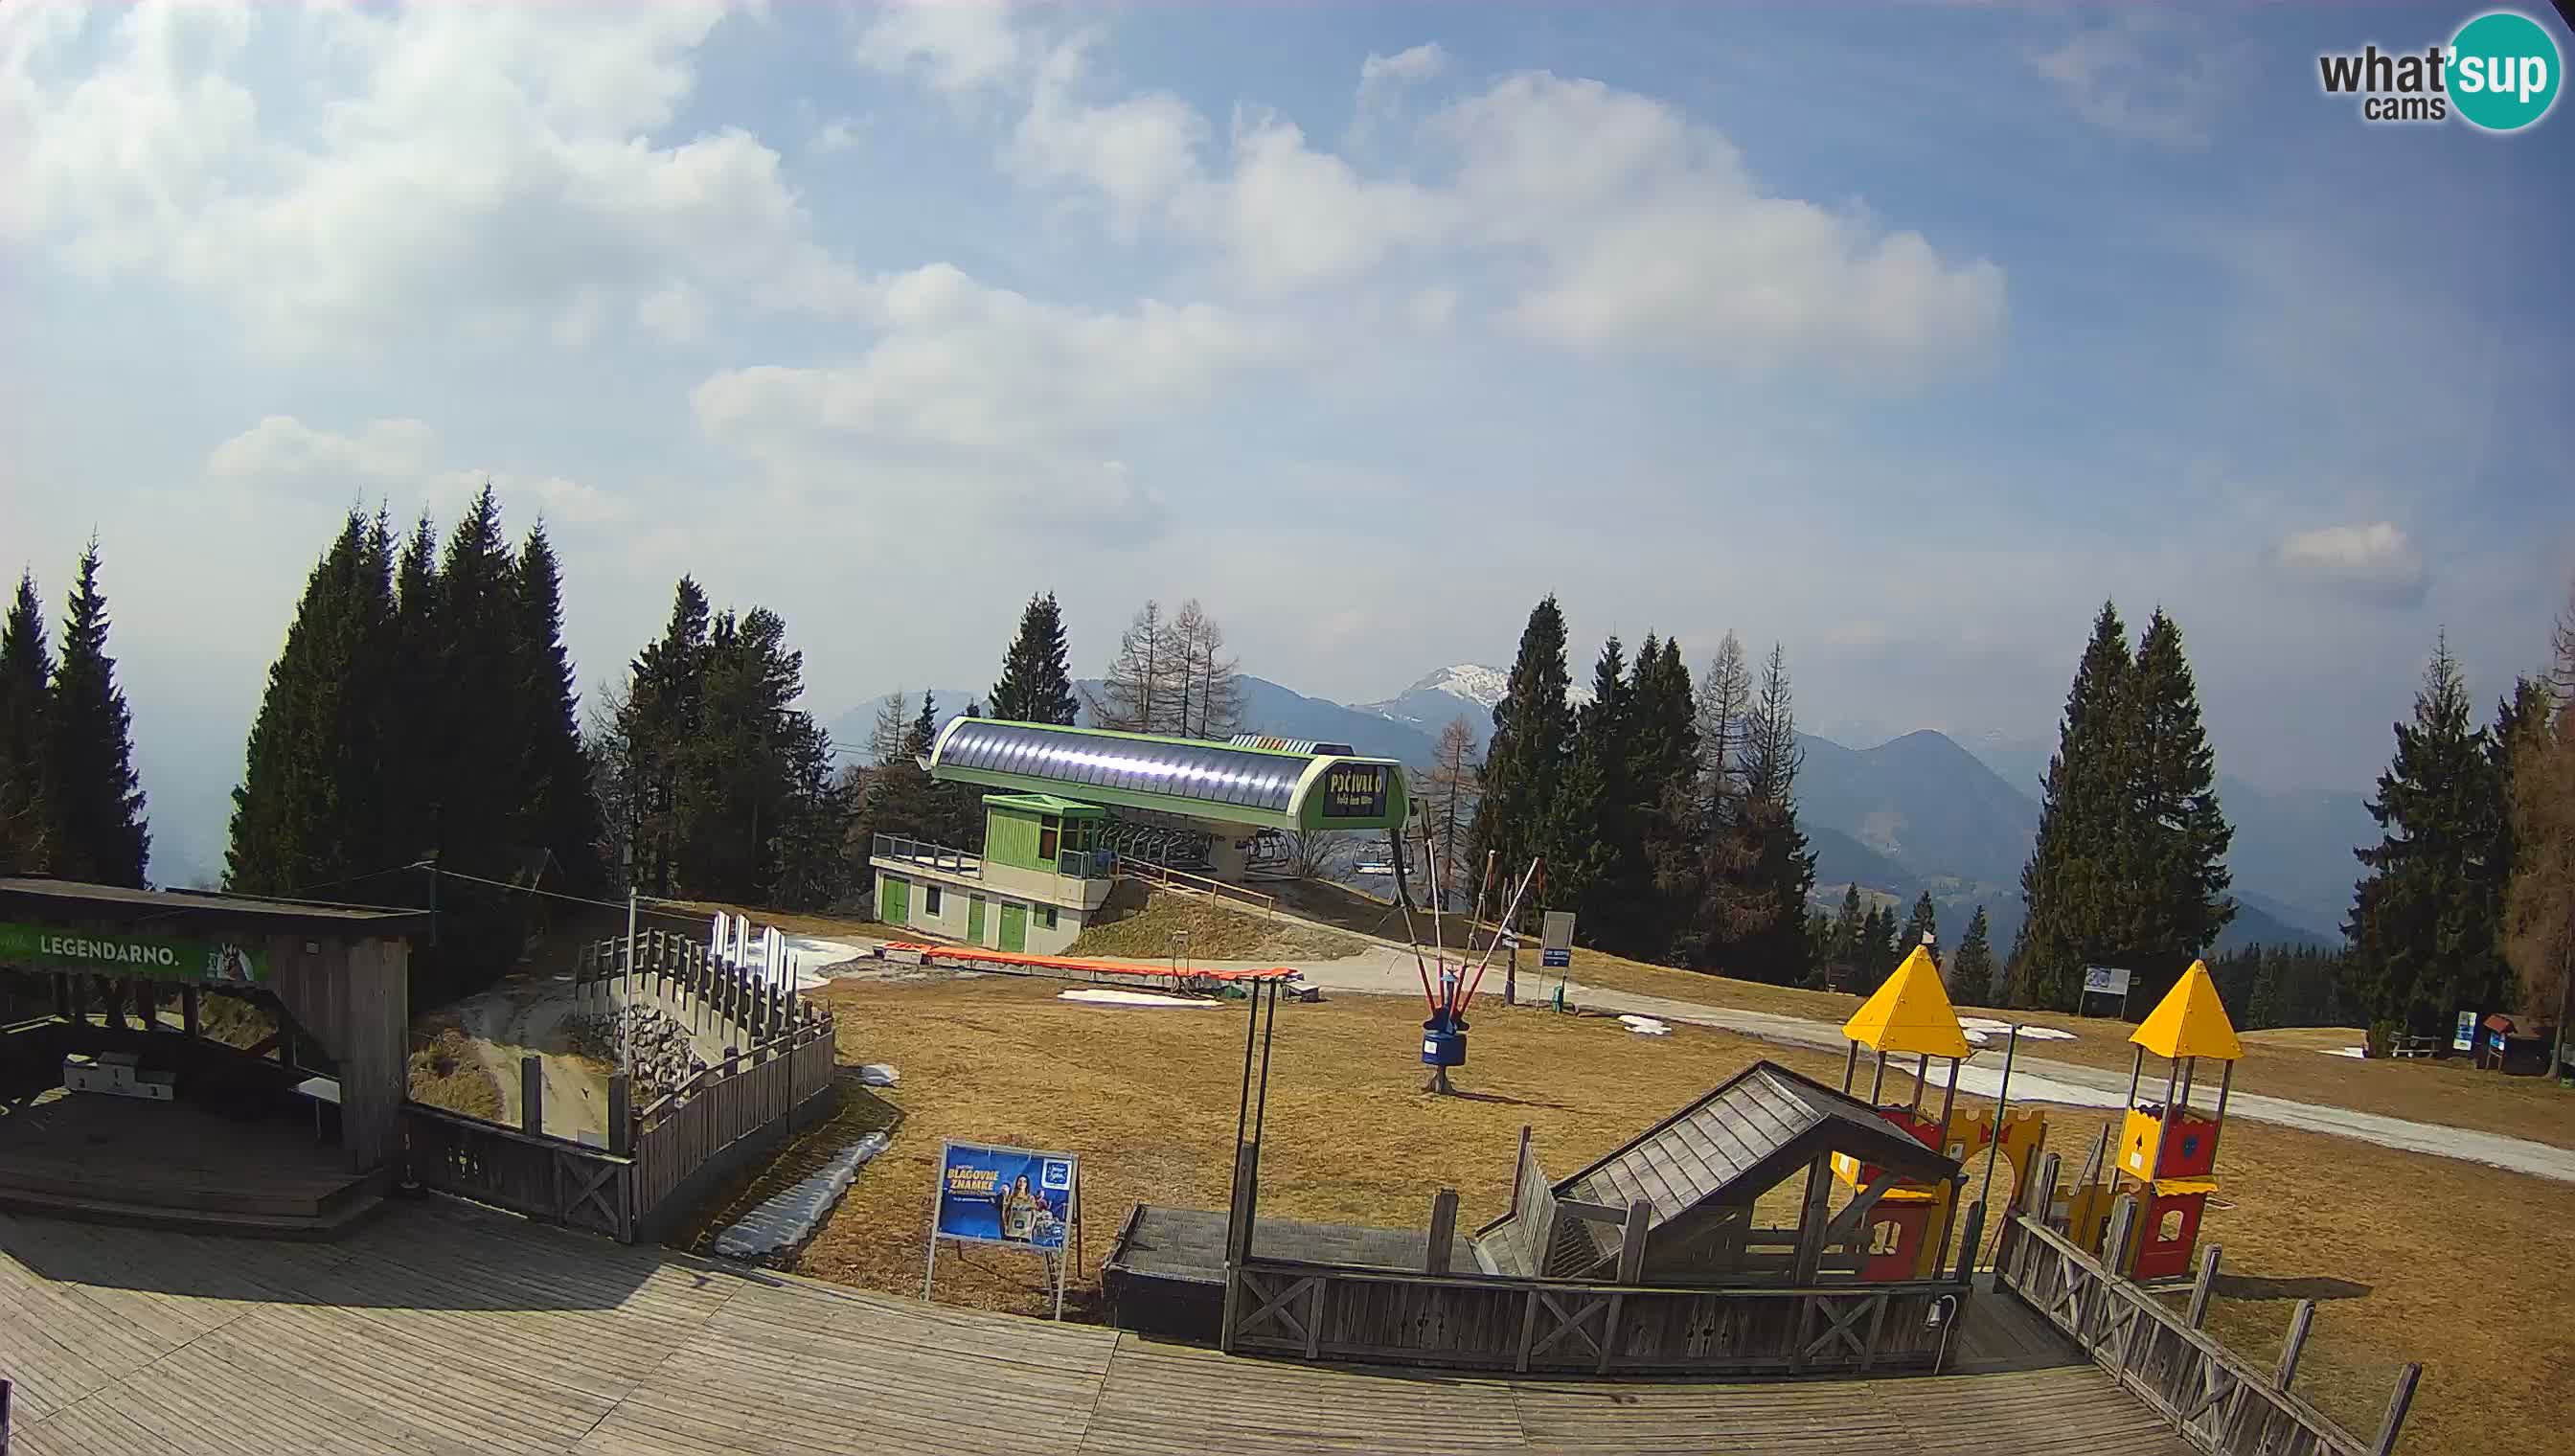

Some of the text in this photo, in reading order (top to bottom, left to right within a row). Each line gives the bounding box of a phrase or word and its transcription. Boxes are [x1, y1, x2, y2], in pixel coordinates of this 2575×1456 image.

[39, 934, 181, 967] LEGENDARNO.
[947, 1169, 1000, 1181] BLAGOVNE
[949, 1179, 994, 1191] ZNAMKE
